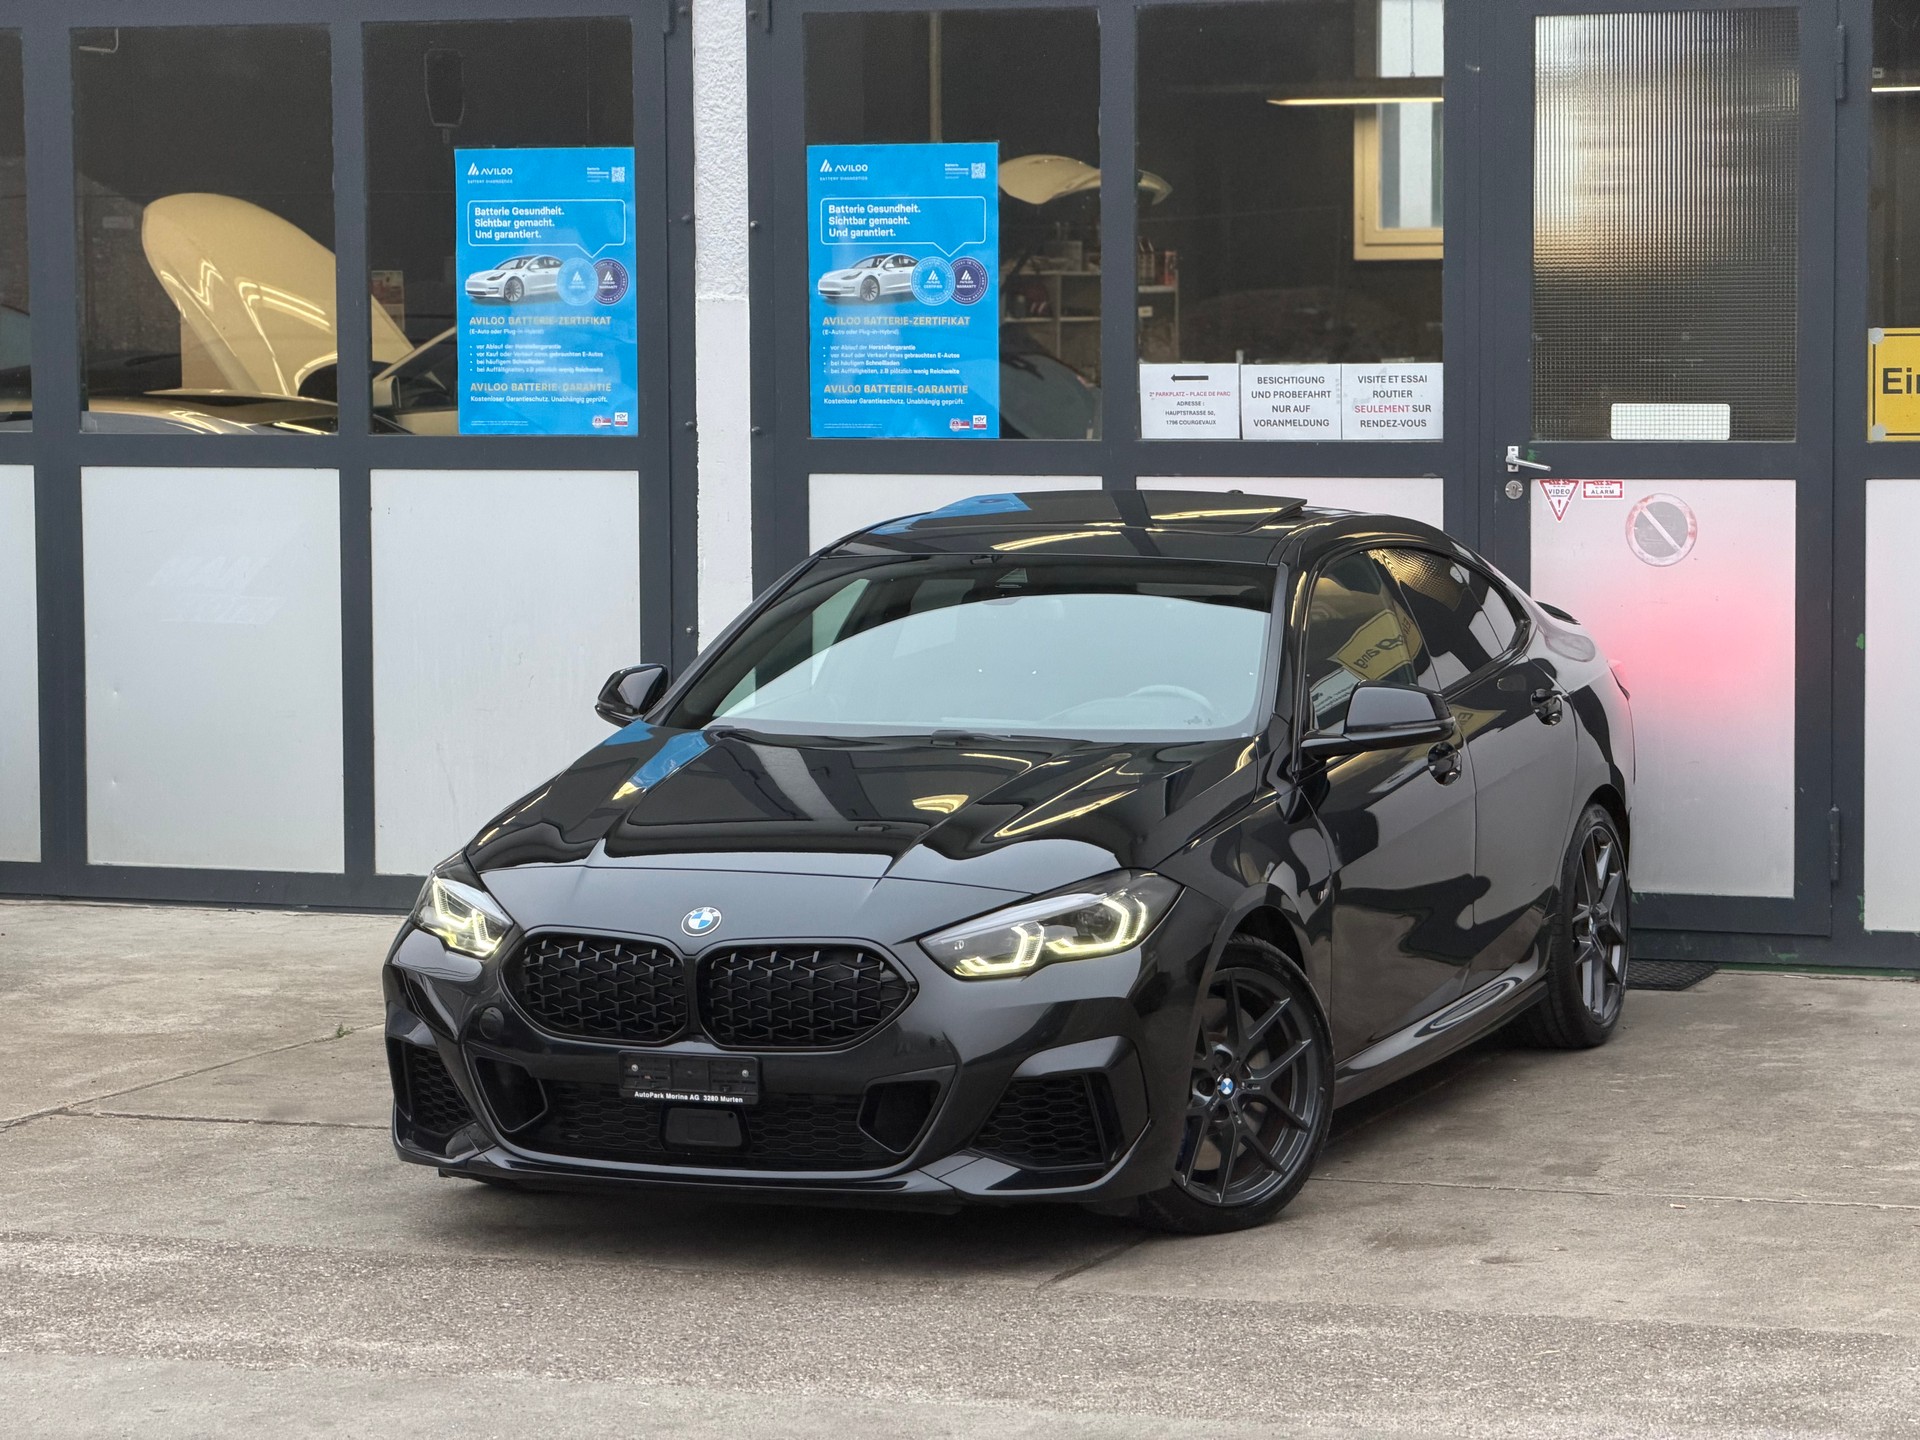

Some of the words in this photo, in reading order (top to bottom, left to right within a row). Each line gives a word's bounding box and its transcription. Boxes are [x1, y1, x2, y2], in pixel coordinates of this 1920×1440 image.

[481, 168, 513, 176] AVILOO
[835, 164, 868, 172] AVILOO
[474, 206, 510, 216] Batterie
[512, 206, 565, 216] Gesundheit.
[828, 204, 865, 214] Batterie
[866, 204, 921, 213] Gesundheit.
[474, 218, 512, 228] Sichtbar
[514, 218, 556, 230] gemacht.
[828, 216, 867, 226] Sichtbar
[868, 216, 911, 228] gemacht.
[475, 230, 492, 239] Und
[494, 229, 542, 241] garantiert.
[828, 228, 848, 237] Und
[850, 227, 897, 239] garantiert.
[470, 316, 504, 326] AVILOO
[822, 316, 861, 326] AVILOO
[864, 316, 970, 326] BATTERIE-ZERTIFIKAT
[1258, 376, 1325, 384] BESICHTIGUNG
[1358, 376, 1386, 384] VISITE
[1388, 376, 1399, 384] ET
[1401, 375, 1428, 384] ESSAI
[1882, 368, 1920, 394] Ei
[470, 382, 508, 392] AVILOO
[512, 382, 612, 392] BATTERIE-GARANTIE
[824, 384, 861, 394] AVILOO
[864, 384, 968, 394] BATTERIE-GARANTIE
[1251, 390, 1272, 399] UND
[1274, 390, 1332, 398] PROBEFAHRT
[1373, 390, 1413, 398] ROUTIER
[551, 396, 585, 404] Unabhängig
[906, 398, 940, 406] Unabhängig
[942, 398, 964, 406] geprüft.
[1272, 404, 1292, 412] NUR
[1293, 404, 1311, 412] AUF
[1354, 404, 1410, 413] SEULEMENT
[1412, 404, 1432, 412] SUR
[1254, 419, 1330, 427] VORANMELDUNG
[1360, 420, 1427, 428] RENDEZ-VOUS
[634, 1091, 664, 1099] AutoPark
